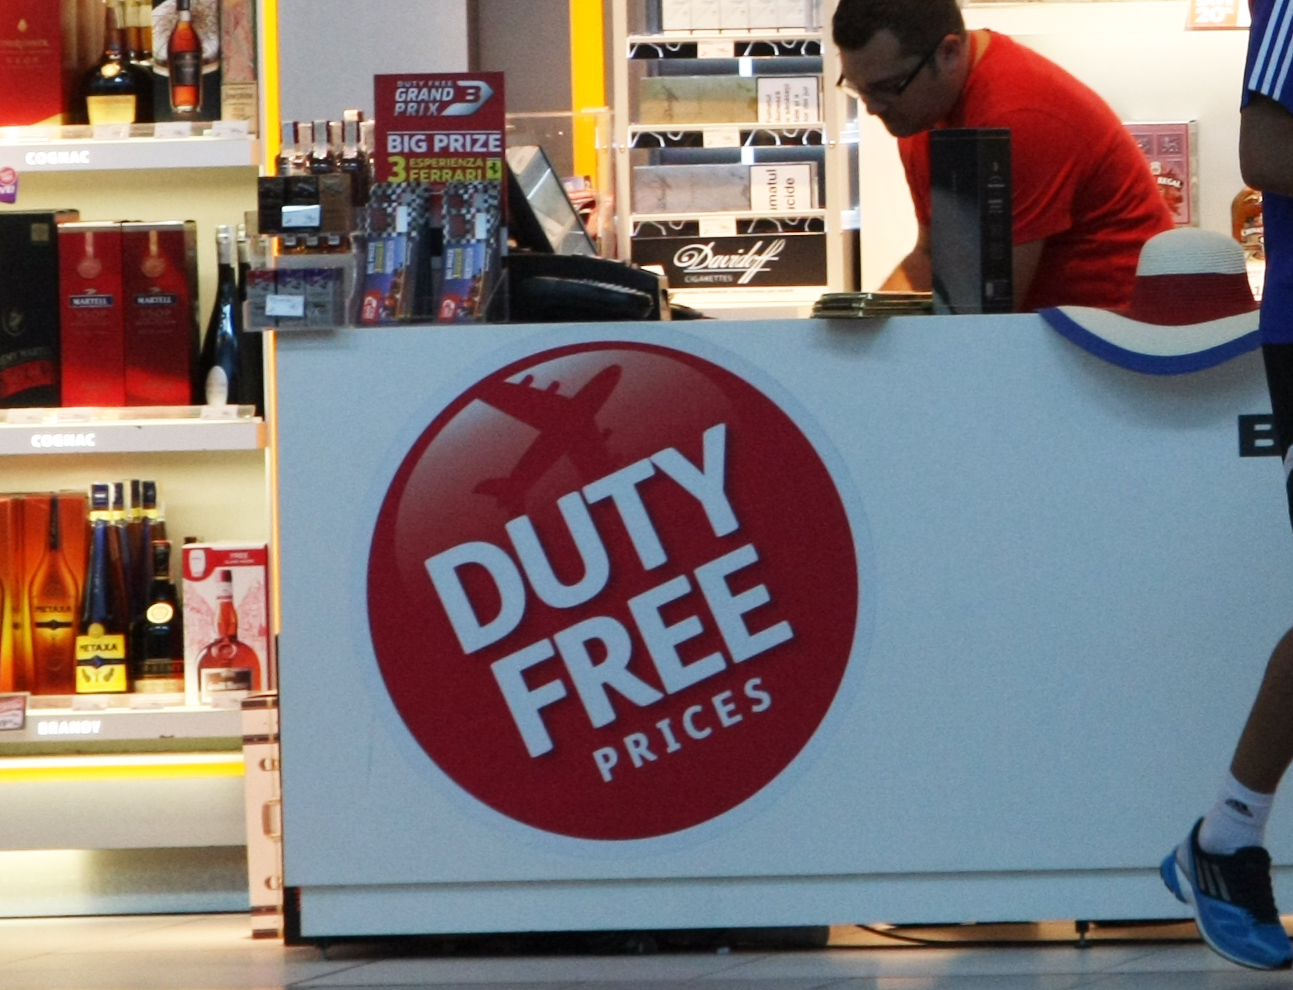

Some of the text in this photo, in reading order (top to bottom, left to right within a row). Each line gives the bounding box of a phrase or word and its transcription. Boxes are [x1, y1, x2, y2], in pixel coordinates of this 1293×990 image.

[395, 87, 454, 102] GRAND
[394, 102, 439, 116] PRIX
[386, 134, 502, 153] BIG PRIZE
[25, 151, 90, 166] COGNAC
[409, 157, 484, 168] ESPERIENZA
[387, 155, 407, 183] 3
[409, 169, 482, 182] FERRARI
[672, 238, 786, 285] Davidoff
[684, 274, 733, 283] CIGARETTES
[72, 297, 107, 305] MARTELL
[137, 296, 172, 304] MARTELL
[31, 433, 96, 448] COGNAC
[425, 422, 740, 655] DUTY
[490, 543, 795, 758] FREE
[37, 720, 101, 735] BRANDY
[592, 676, 772, 782] PRICES
